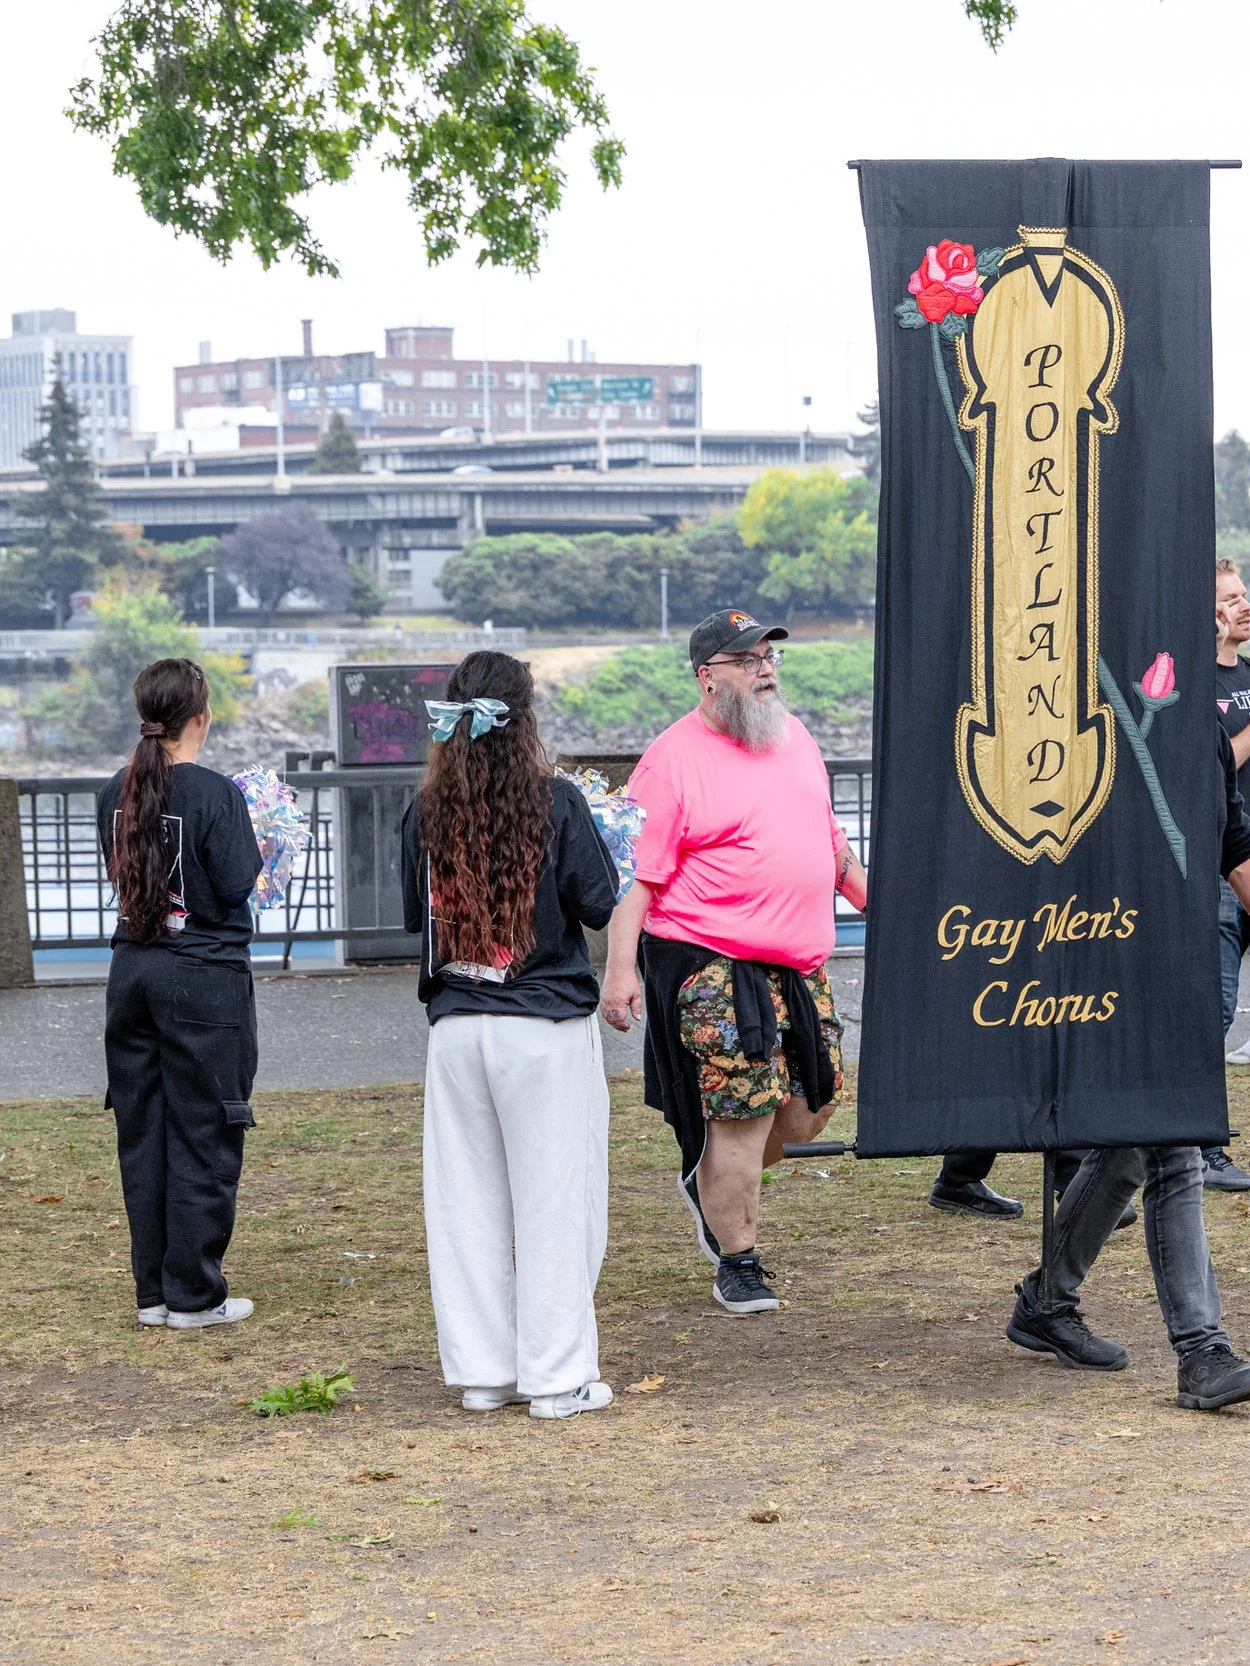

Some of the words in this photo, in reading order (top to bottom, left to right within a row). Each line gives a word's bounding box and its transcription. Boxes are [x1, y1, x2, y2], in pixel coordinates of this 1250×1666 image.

[1017, 344, 1066, 784] PORTLAND
[937, 904, 1026, 965] Gay
[1033, 895, 1139, 952] Men's
[972, 980, 1119, 1027] Chorus
